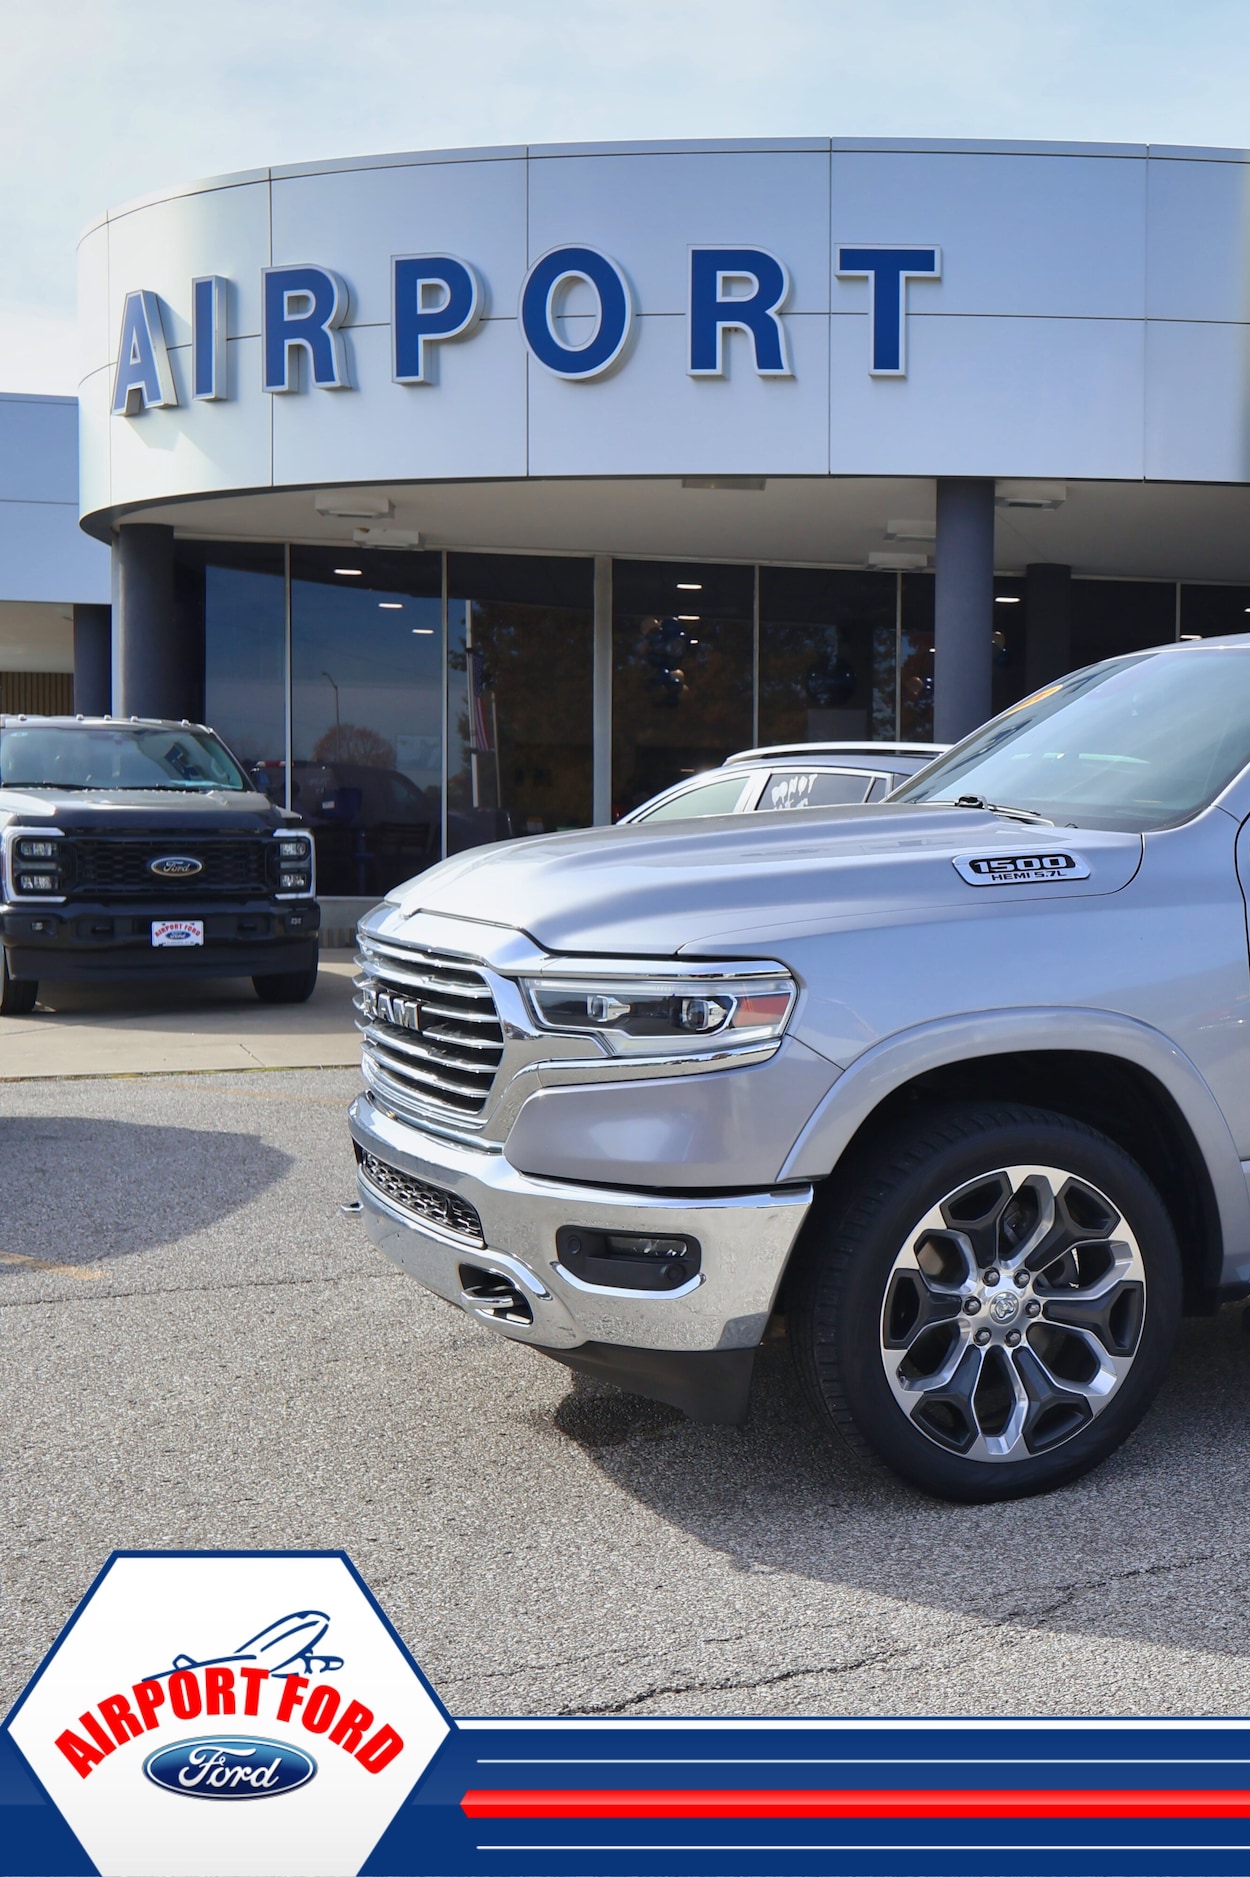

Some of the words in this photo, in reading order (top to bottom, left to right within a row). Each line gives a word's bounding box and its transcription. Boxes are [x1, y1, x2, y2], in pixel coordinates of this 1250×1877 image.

[109, 242, 942, 418] AIRPORT
[163, 860, 191, 873] Ford
[974, 856, 1067, 873] 1500
[991, 871, 1031, 881] HEMI
[1034, 870, 1067, 878] 5.7L
[154, 923, 182, 938] AIRPORT
[184, 924, 201, 937] FORD
[363, 988, 421, 1032] RAM
